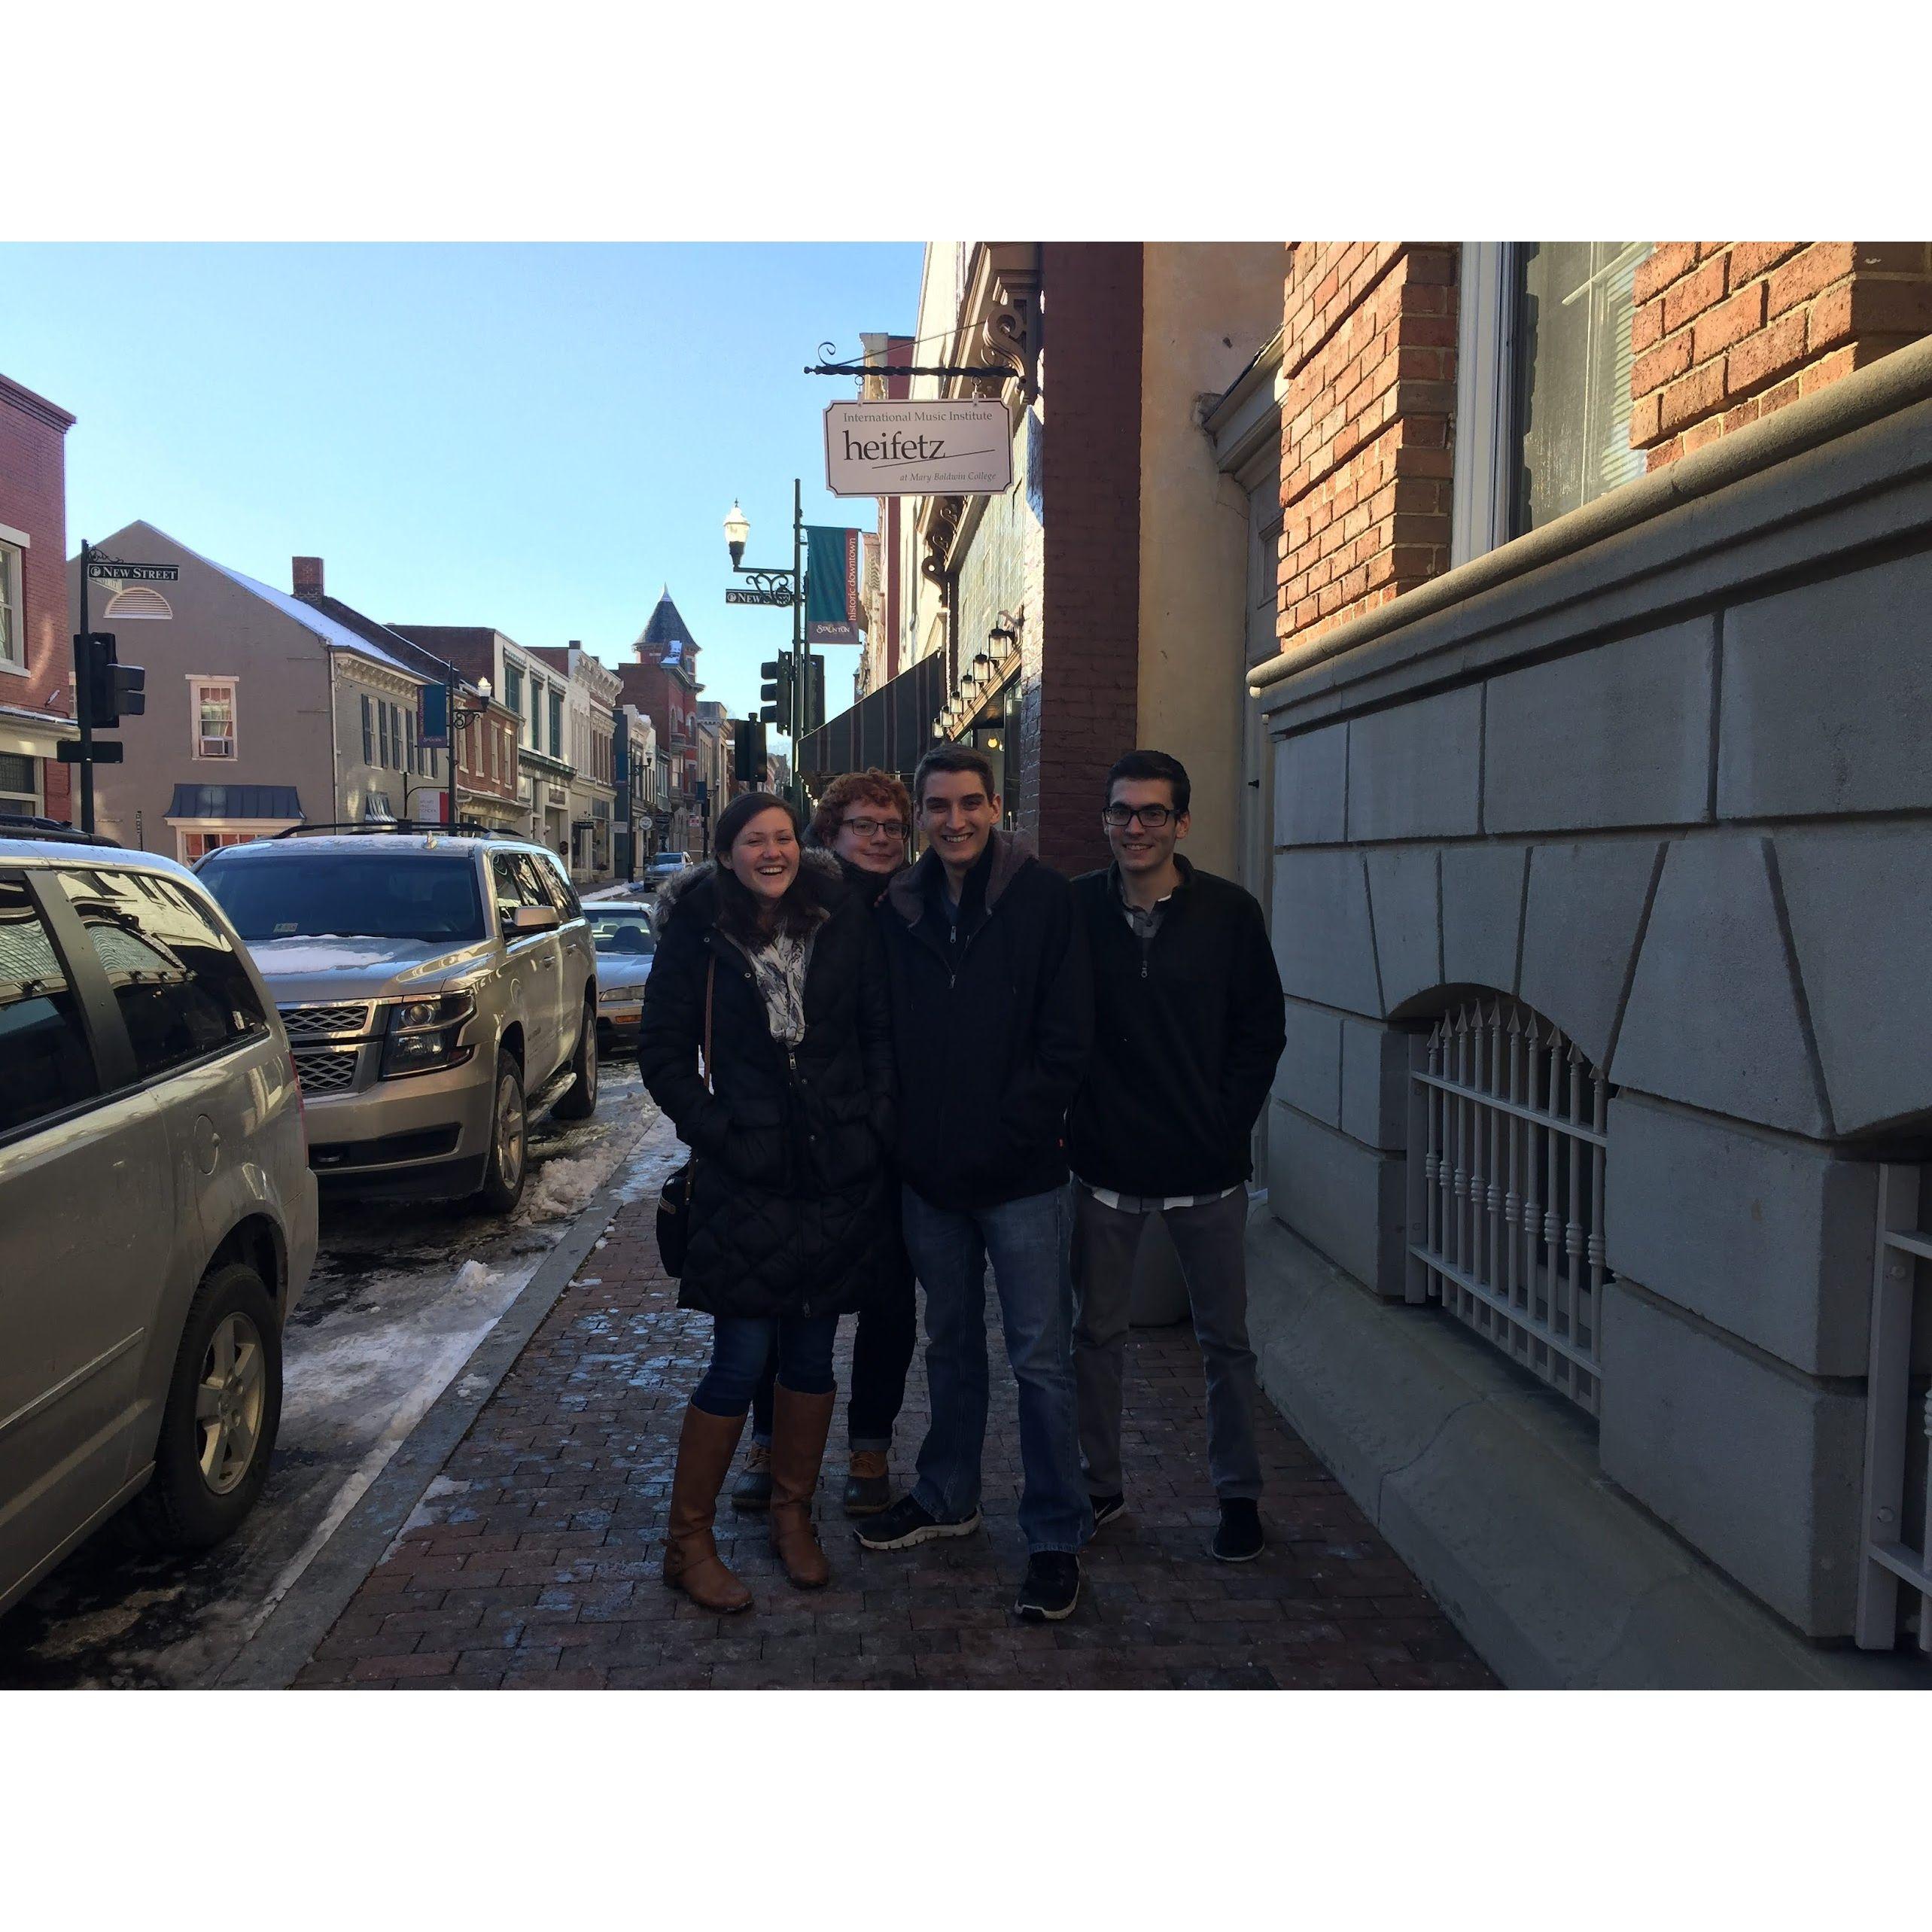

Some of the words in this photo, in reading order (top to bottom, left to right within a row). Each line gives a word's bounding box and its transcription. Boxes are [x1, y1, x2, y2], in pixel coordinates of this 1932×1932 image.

[843, 412, 911, 422] International
[914, 412, 947, 421] Music
[949, 411, 993, 421] Institute
[842, 430, 945, 461] heifetz
[910, 473, 932, 483] Mary
[934, 472, 966, 482] Baldwin
[968, 471, 996, 482] College
[847, 537, 856, 583] downtown
[103, 566, 130, 577] NEW
[132, 567, 177, 580] STREET
[848, 583, 856, 621] historic
